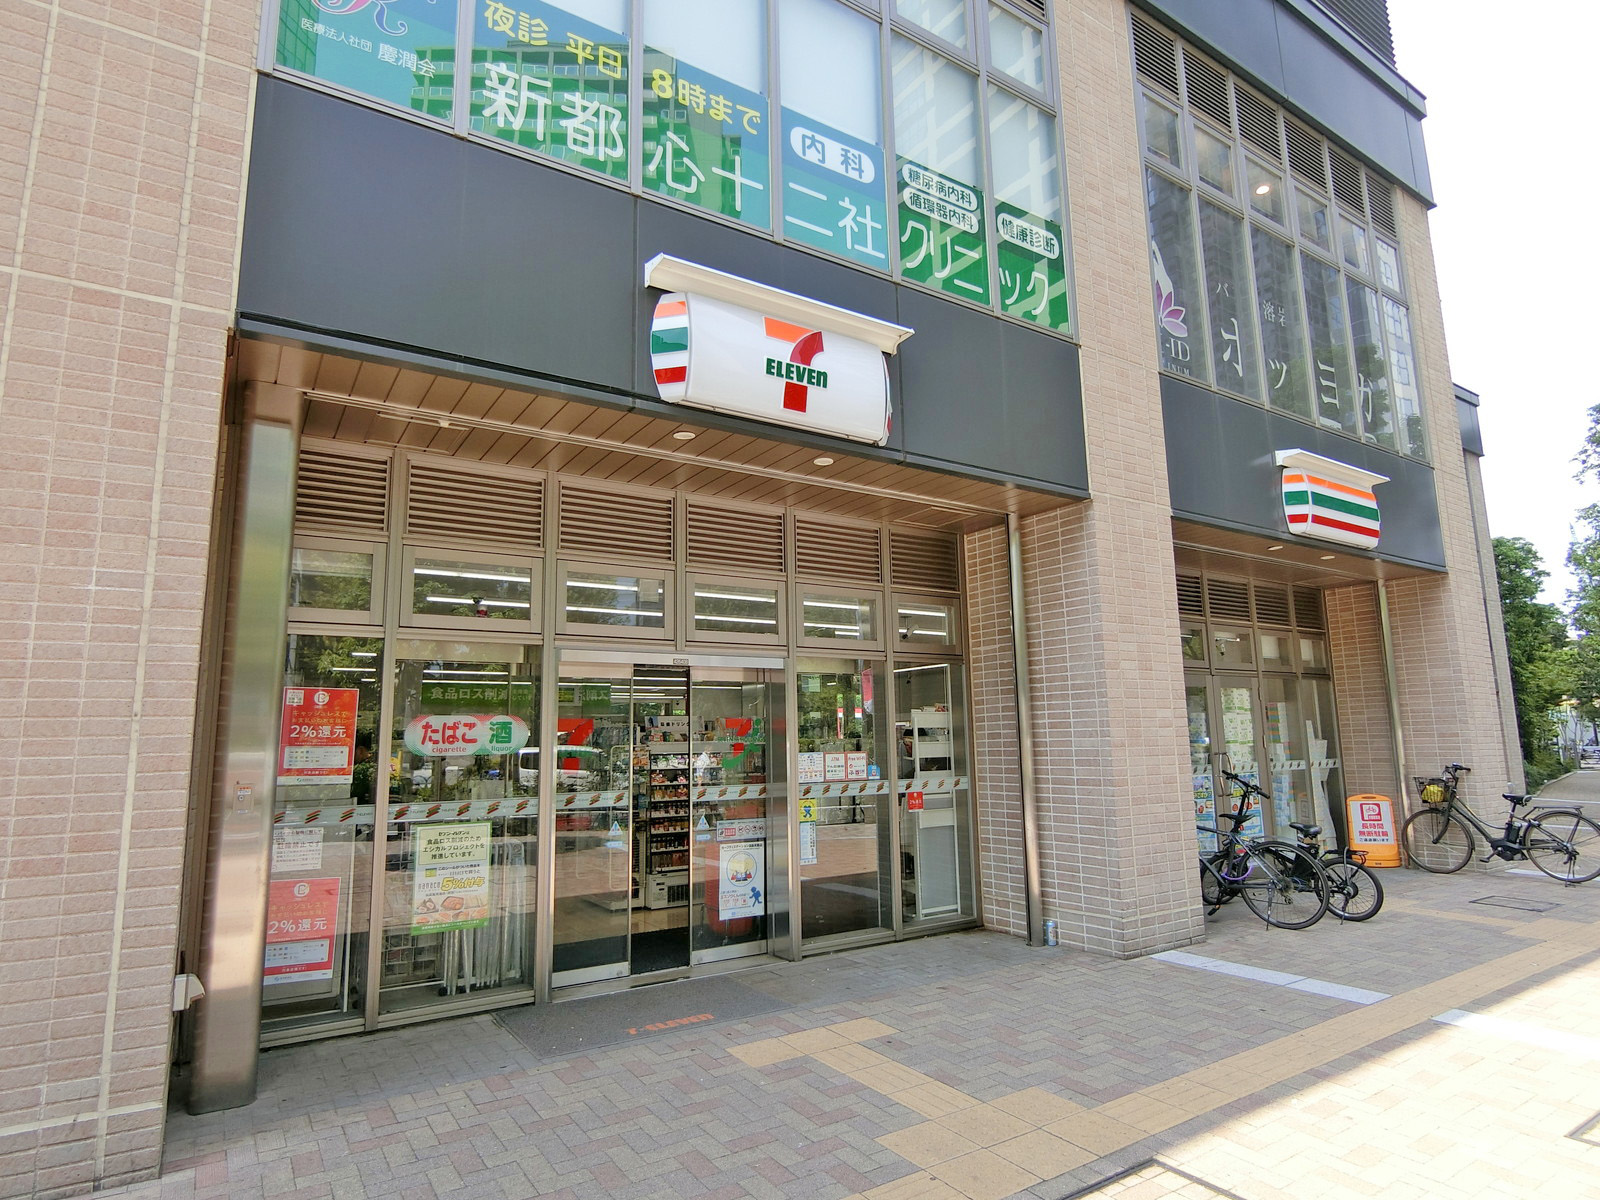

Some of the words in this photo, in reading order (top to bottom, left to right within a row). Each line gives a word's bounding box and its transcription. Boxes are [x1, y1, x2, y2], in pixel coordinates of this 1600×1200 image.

[301, 17, 372, 54] 医療法人社団
[377, 42, 436, 79] 慶潤会
[483, 0, 549, 47] 夜診
[565, 32, 622, 79] 平日
[651, 69, 761, 135] 8時まで
[801, 133, 864, 180] 内科
[907, 167, 973, 208] 糖尿病内科
[908, 191, 974, 231] 循環器内科
[1001, 216, 1056, 256] 健康診断
[421, 720, 478, 745] たばこ
[489, 721, 513, 744] 酒
[432, 746, 467, 754] cigarette
[490, 745, 512, 753] liquor
